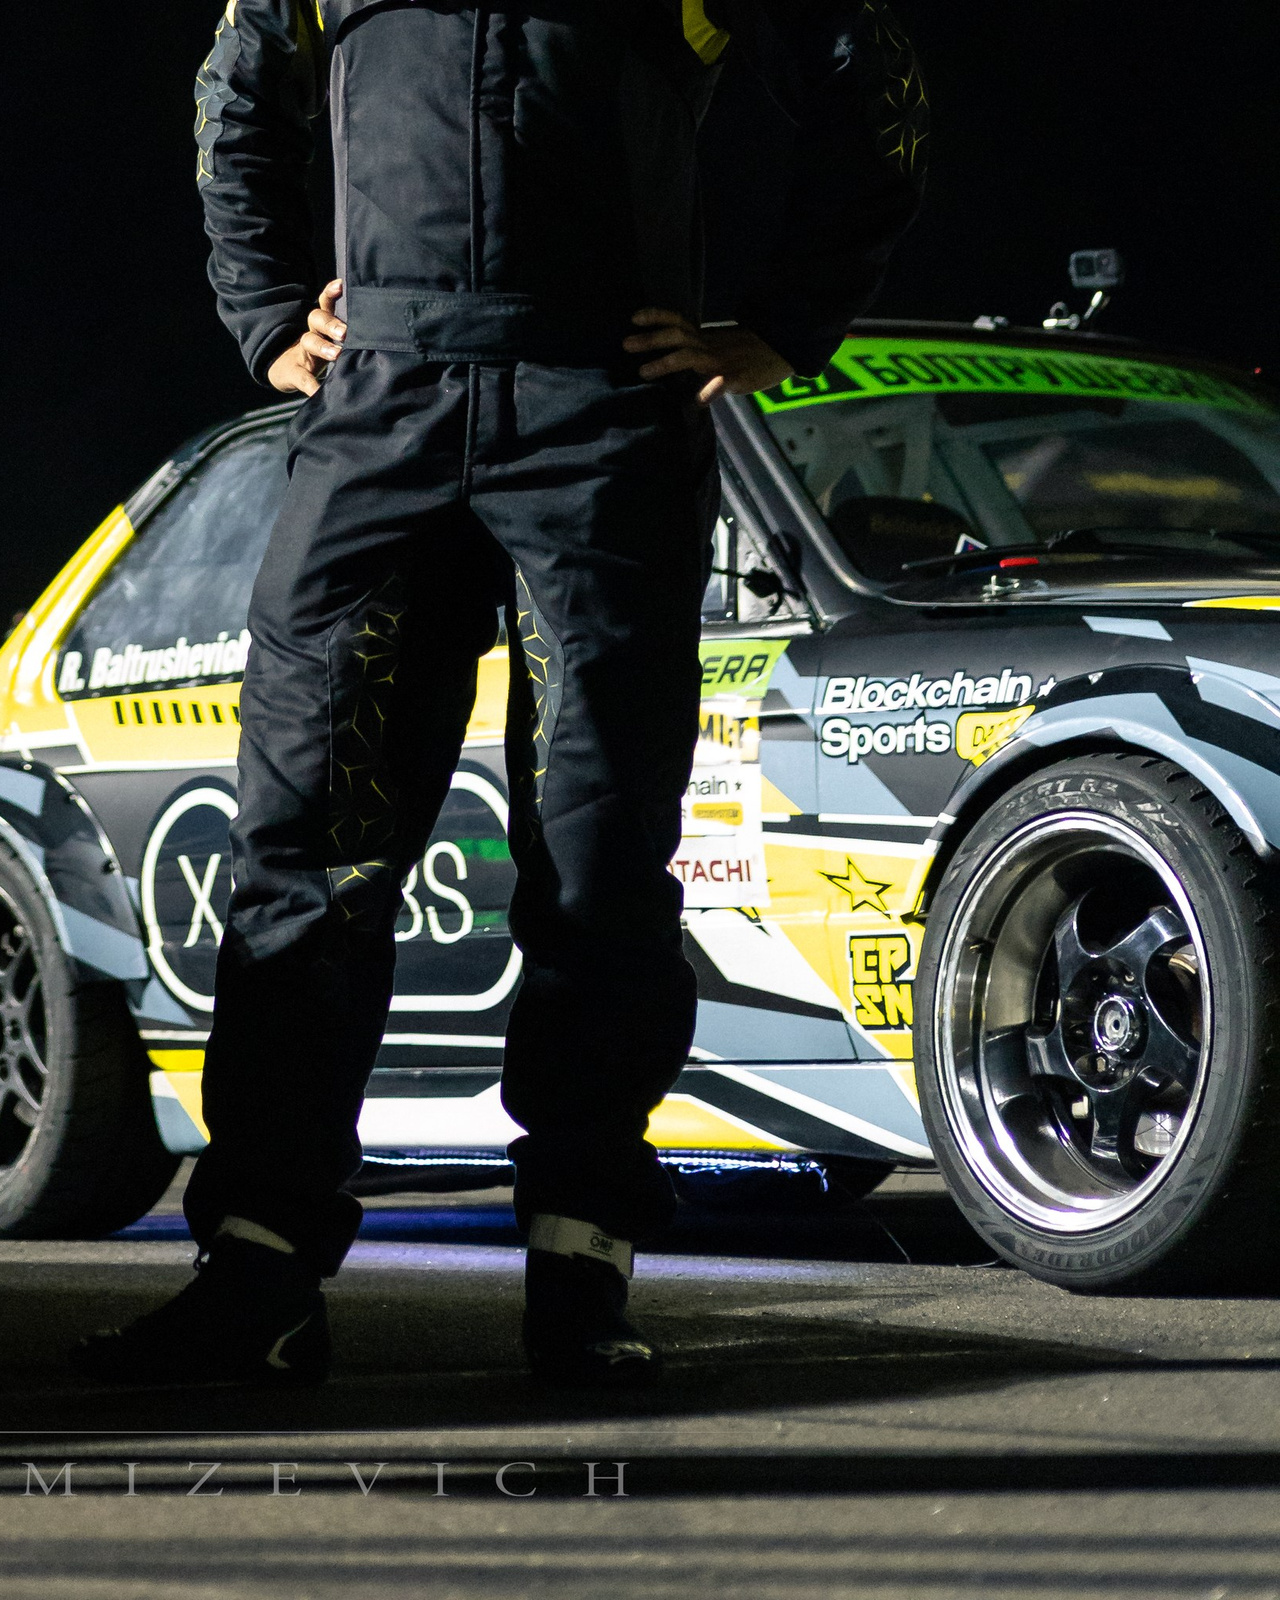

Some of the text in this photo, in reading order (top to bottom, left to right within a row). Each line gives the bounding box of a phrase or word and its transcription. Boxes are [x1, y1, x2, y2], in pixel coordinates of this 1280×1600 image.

[57, 650, 86, 693] R.
[701, 654, 770, 685] ERA
[822, 668, 1033, 709] Blockchain
[821, 715, 952, 764] Sports
[667, 860, 752, 883] TACHI
